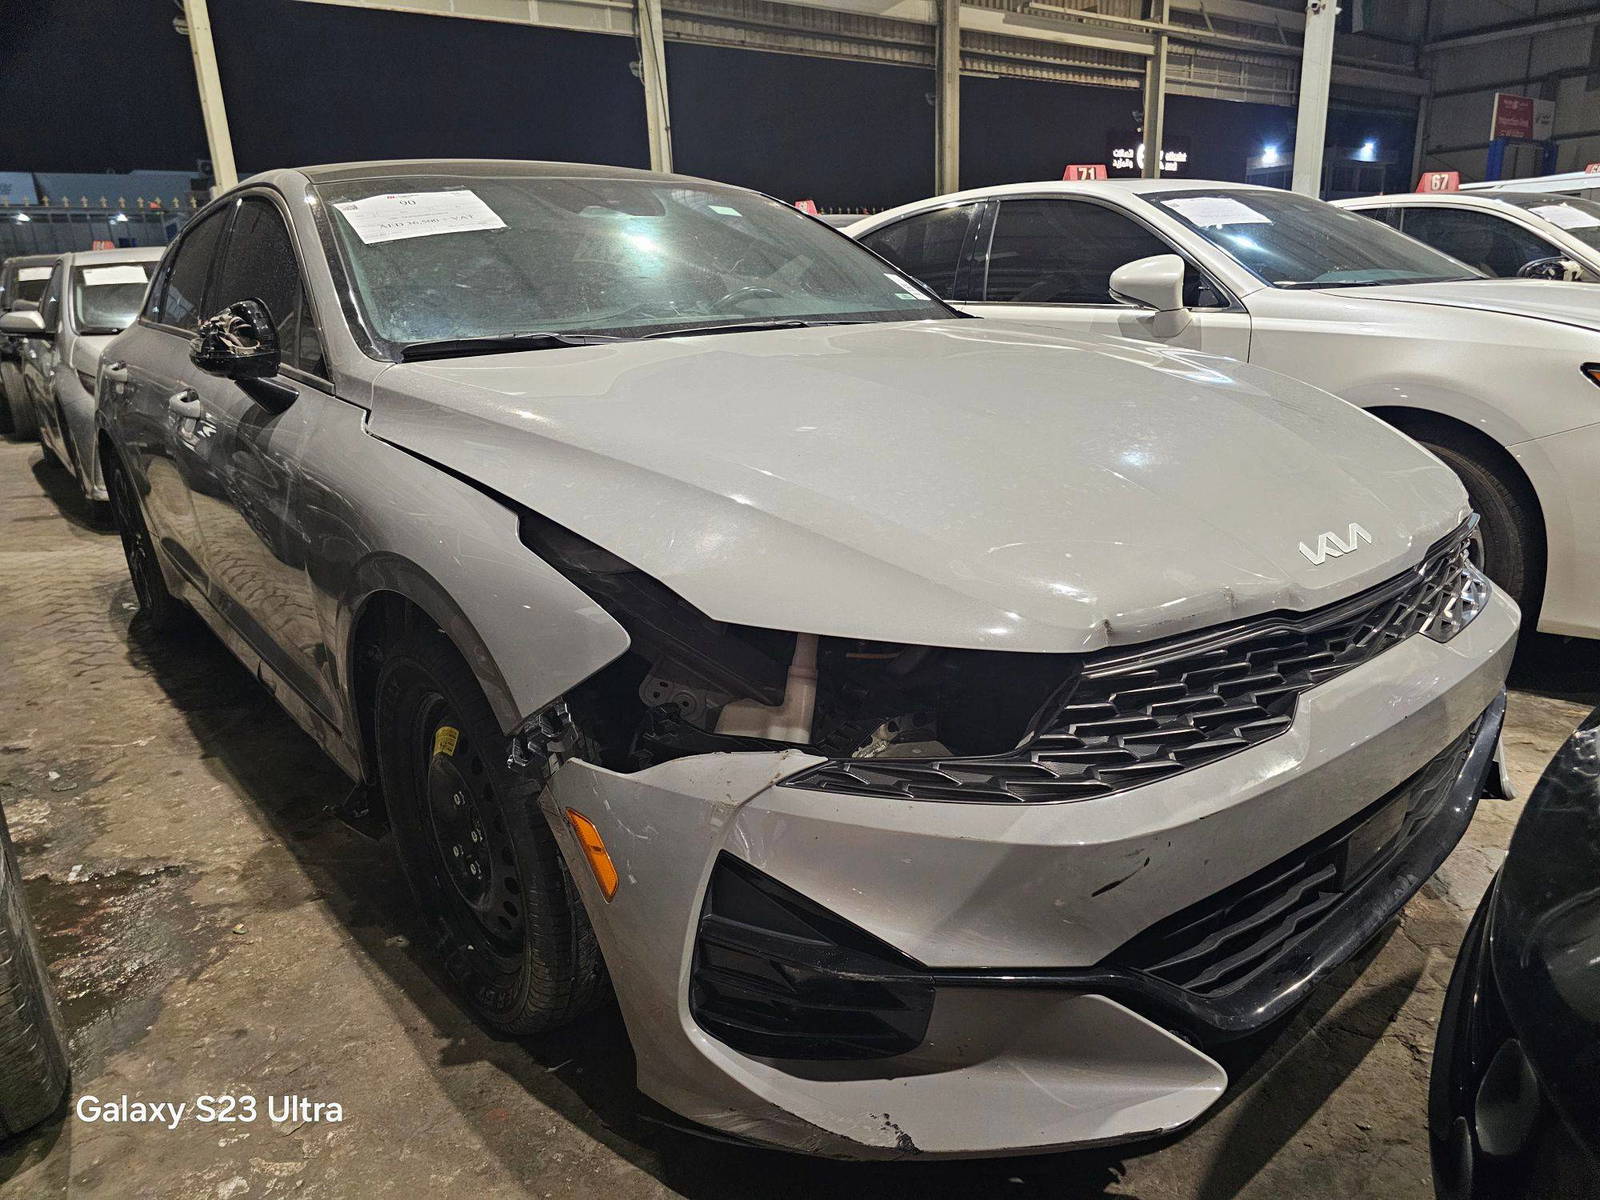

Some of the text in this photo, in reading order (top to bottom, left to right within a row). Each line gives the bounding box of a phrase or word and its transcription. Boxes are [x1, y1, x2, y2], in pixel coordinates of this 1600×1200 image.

[1078, 167, 1095, 181] 71
[1431, 174, 1449, 190] 67
[399, 199, 417, 207] 90
